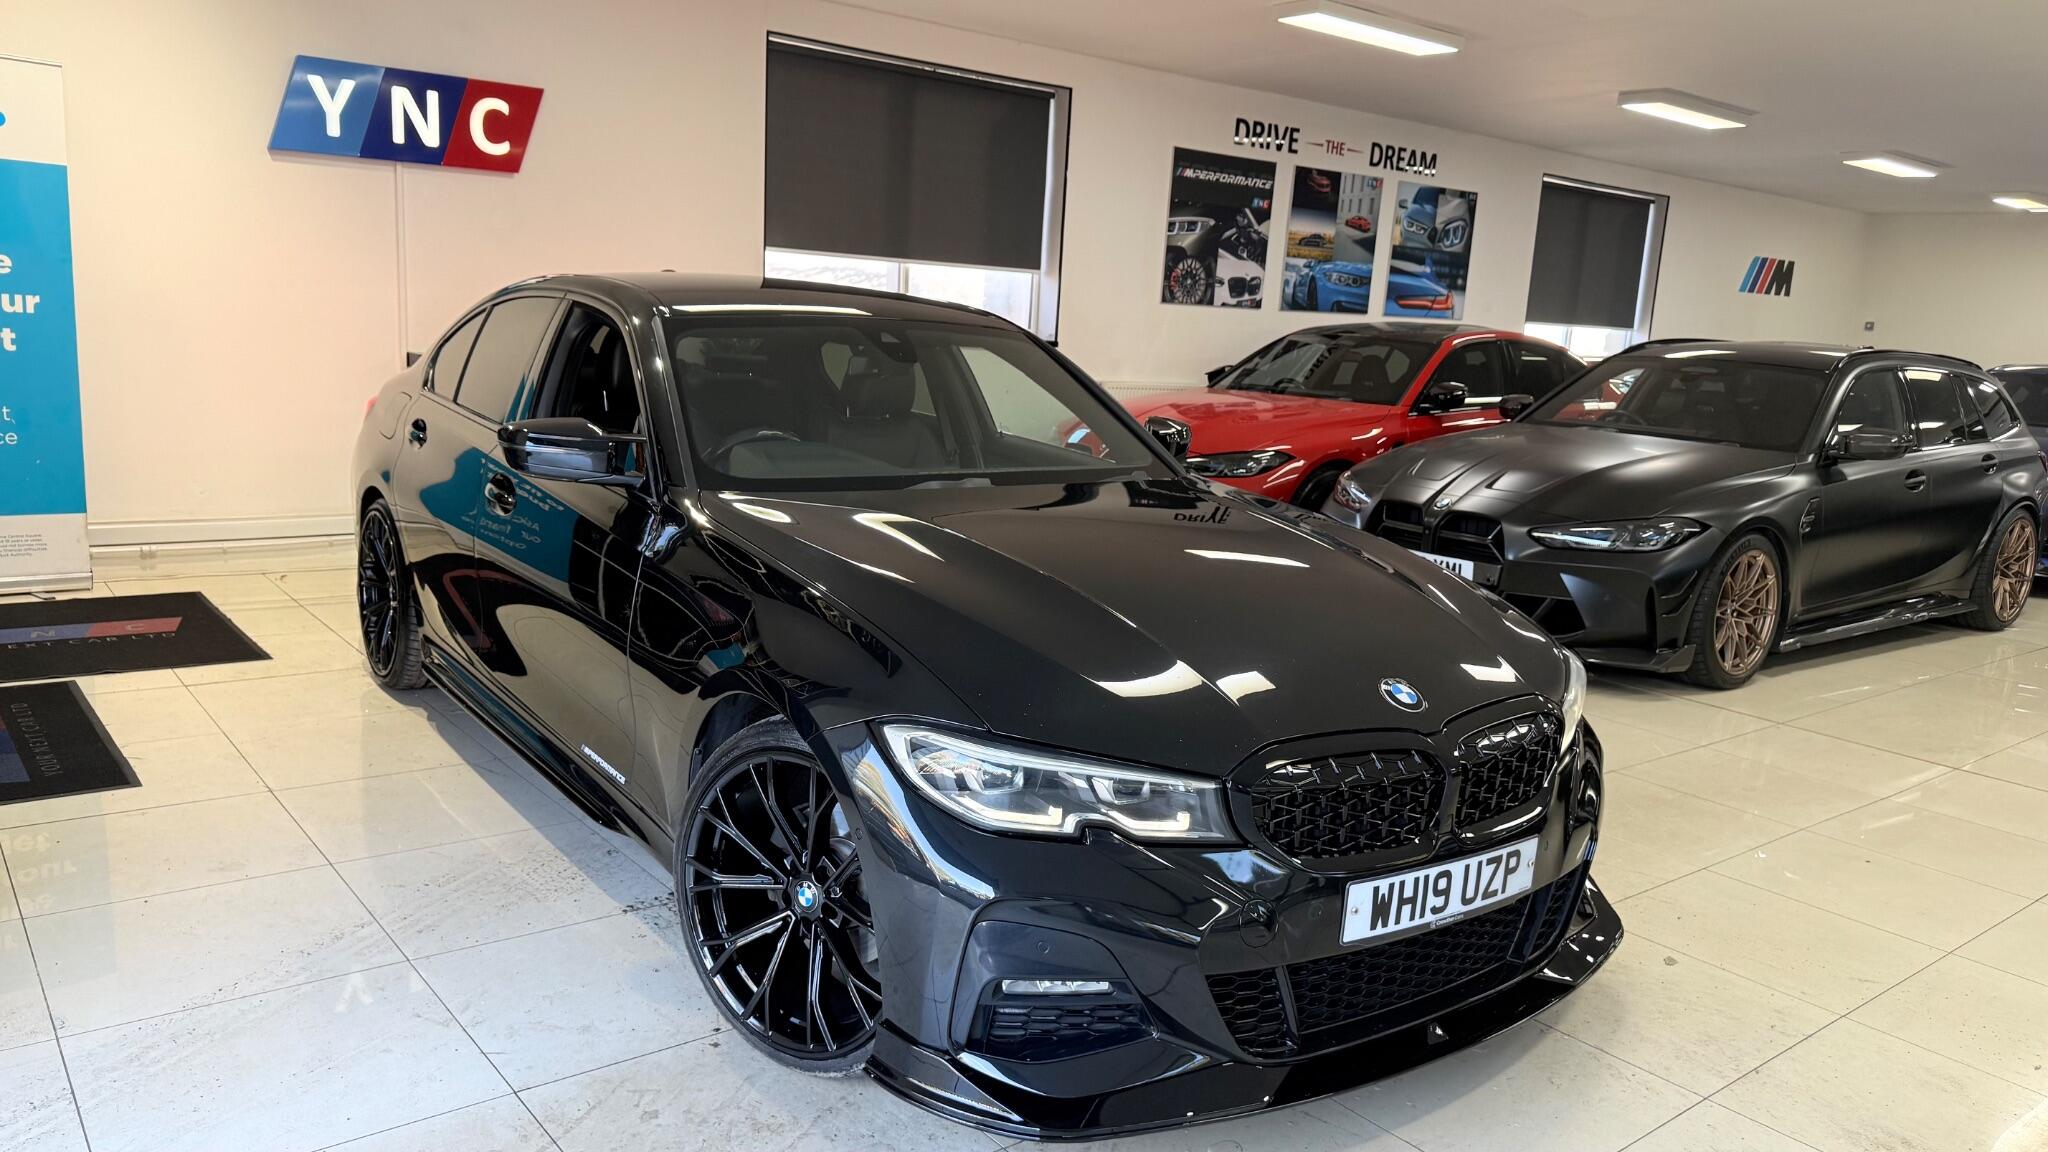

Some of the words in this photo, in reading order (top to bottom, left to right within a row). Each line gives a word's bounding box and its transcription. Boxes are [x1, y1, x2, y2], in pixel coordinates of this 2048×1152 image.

[307, 74, 511, 156] YNC
[1234, 117, 1300, 154] DRIVE
[1325, 139, 1345, 156] THE
[1369, 142, 1437, 177] DREAM
[1370, 870, 1453, 931] WH19
[1460, 849, 1522, 906] UZP
